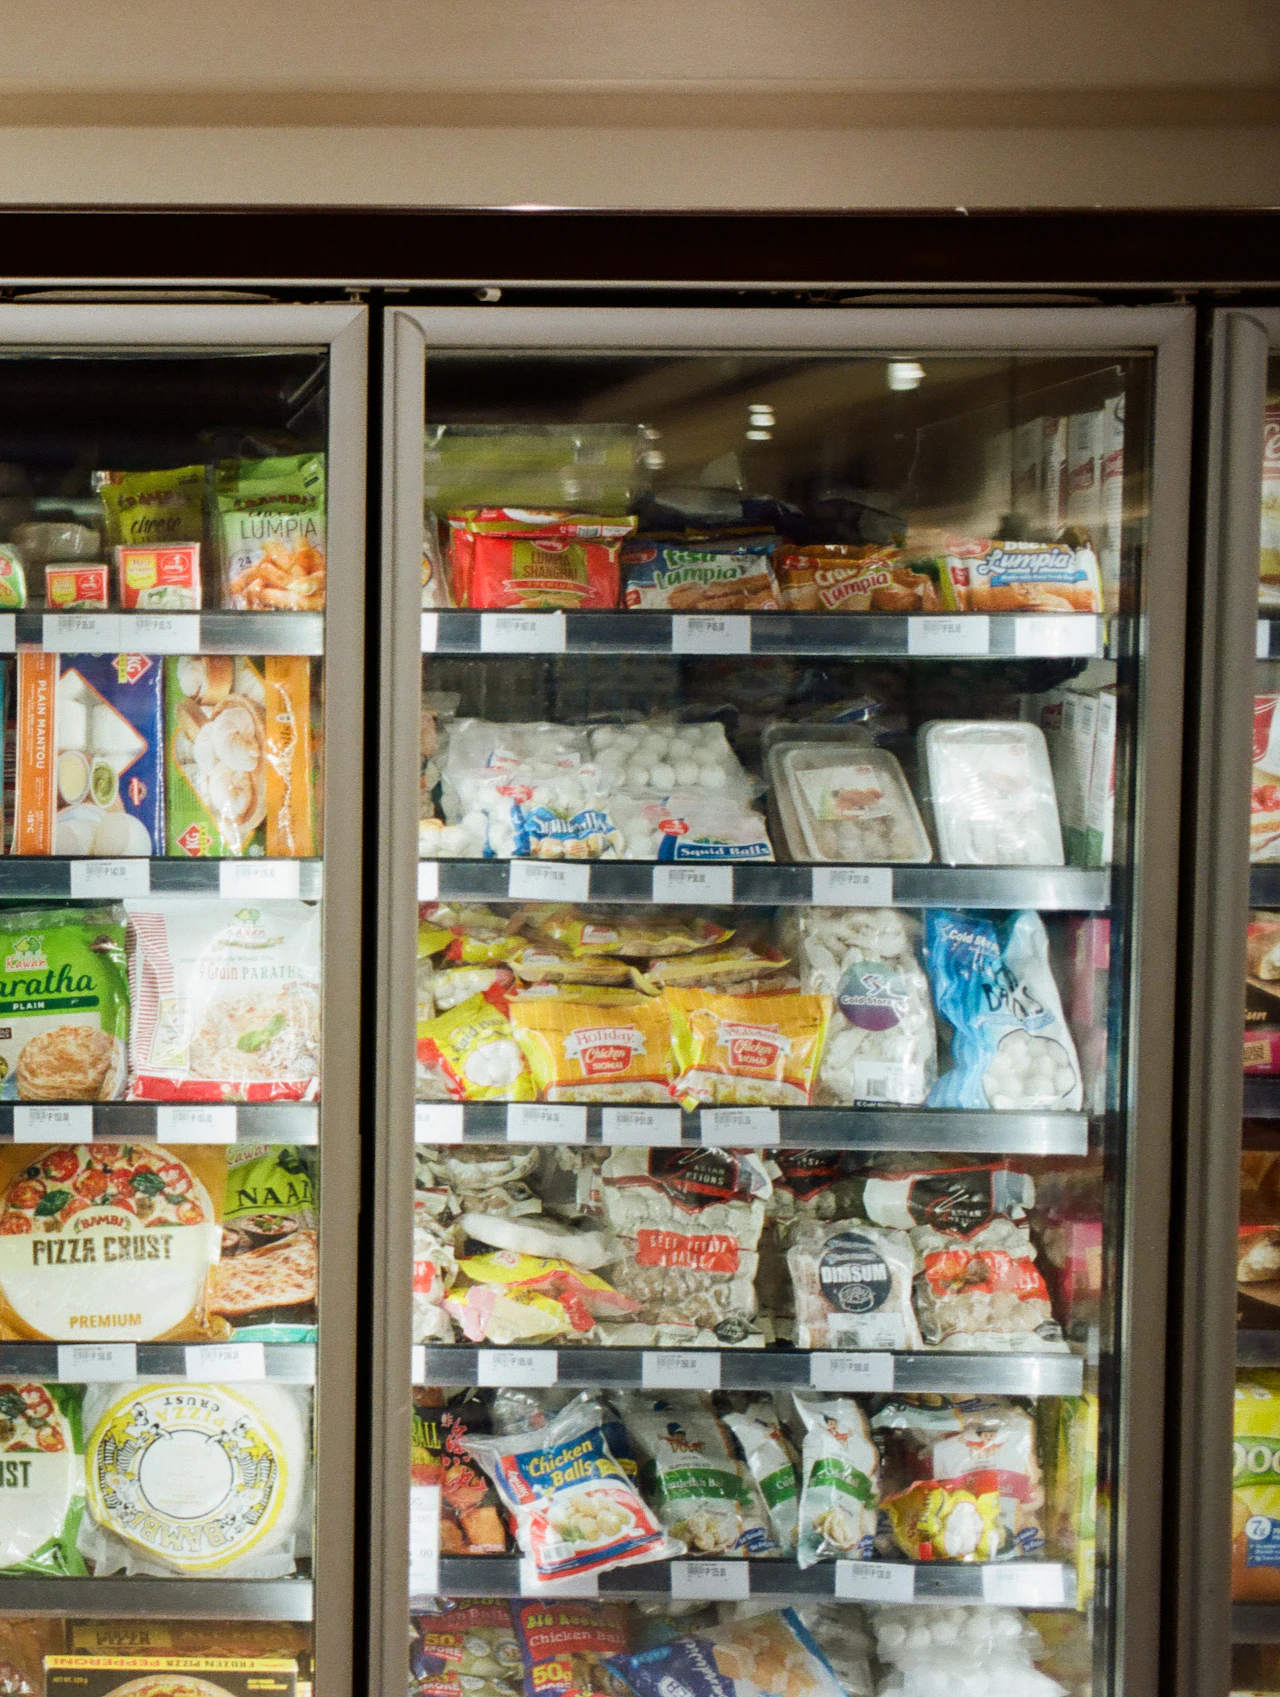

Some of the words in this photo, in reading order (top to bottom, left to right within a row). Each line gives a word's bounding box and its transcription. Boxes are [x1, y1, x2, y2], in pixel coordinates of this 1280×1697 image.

[240, 517, 318, 540] LUMPIA
[237, 556, 253, 568] 24
[976, 547, 1073, 577] Lumpia
[821, 572, 890, 608] Lumpia
[36, 680, 47, 715] PLAIN
[35, 718, 47, 770] MANTOU
[6, 955, 48, 970] Kawan
[207, 962, 239, 980] Grain
[241, 964, 305, 981] PARATHA
[12, 1001, 46, 1012] PLAIN
[575, 1028, 634, 1046] Holiday
[584, 1047, 626, 1063] Chicken
[79, 1213, 125, 1231] BAMBI
[32, 1236, 97, 1266] PIZZA
[103, 1233, 174, 1264] CRUST
[819, 1262, 889, 1285] DIMSUM
[69, 1312, 143, 1330] PREMIUM
[162, 1395, 221, 1414] CRUST
[153, 1404, 228, 1428] PIZZA
[527, 1439, 594, 1476] Chicken
[549, 1460, 593, 1488] Balls
[128, 1507, 230, 1554] BAMBI
[528, 1630, 594, 1648] Chicken
[53, 1657, 161, 1668] PEPPERONI
